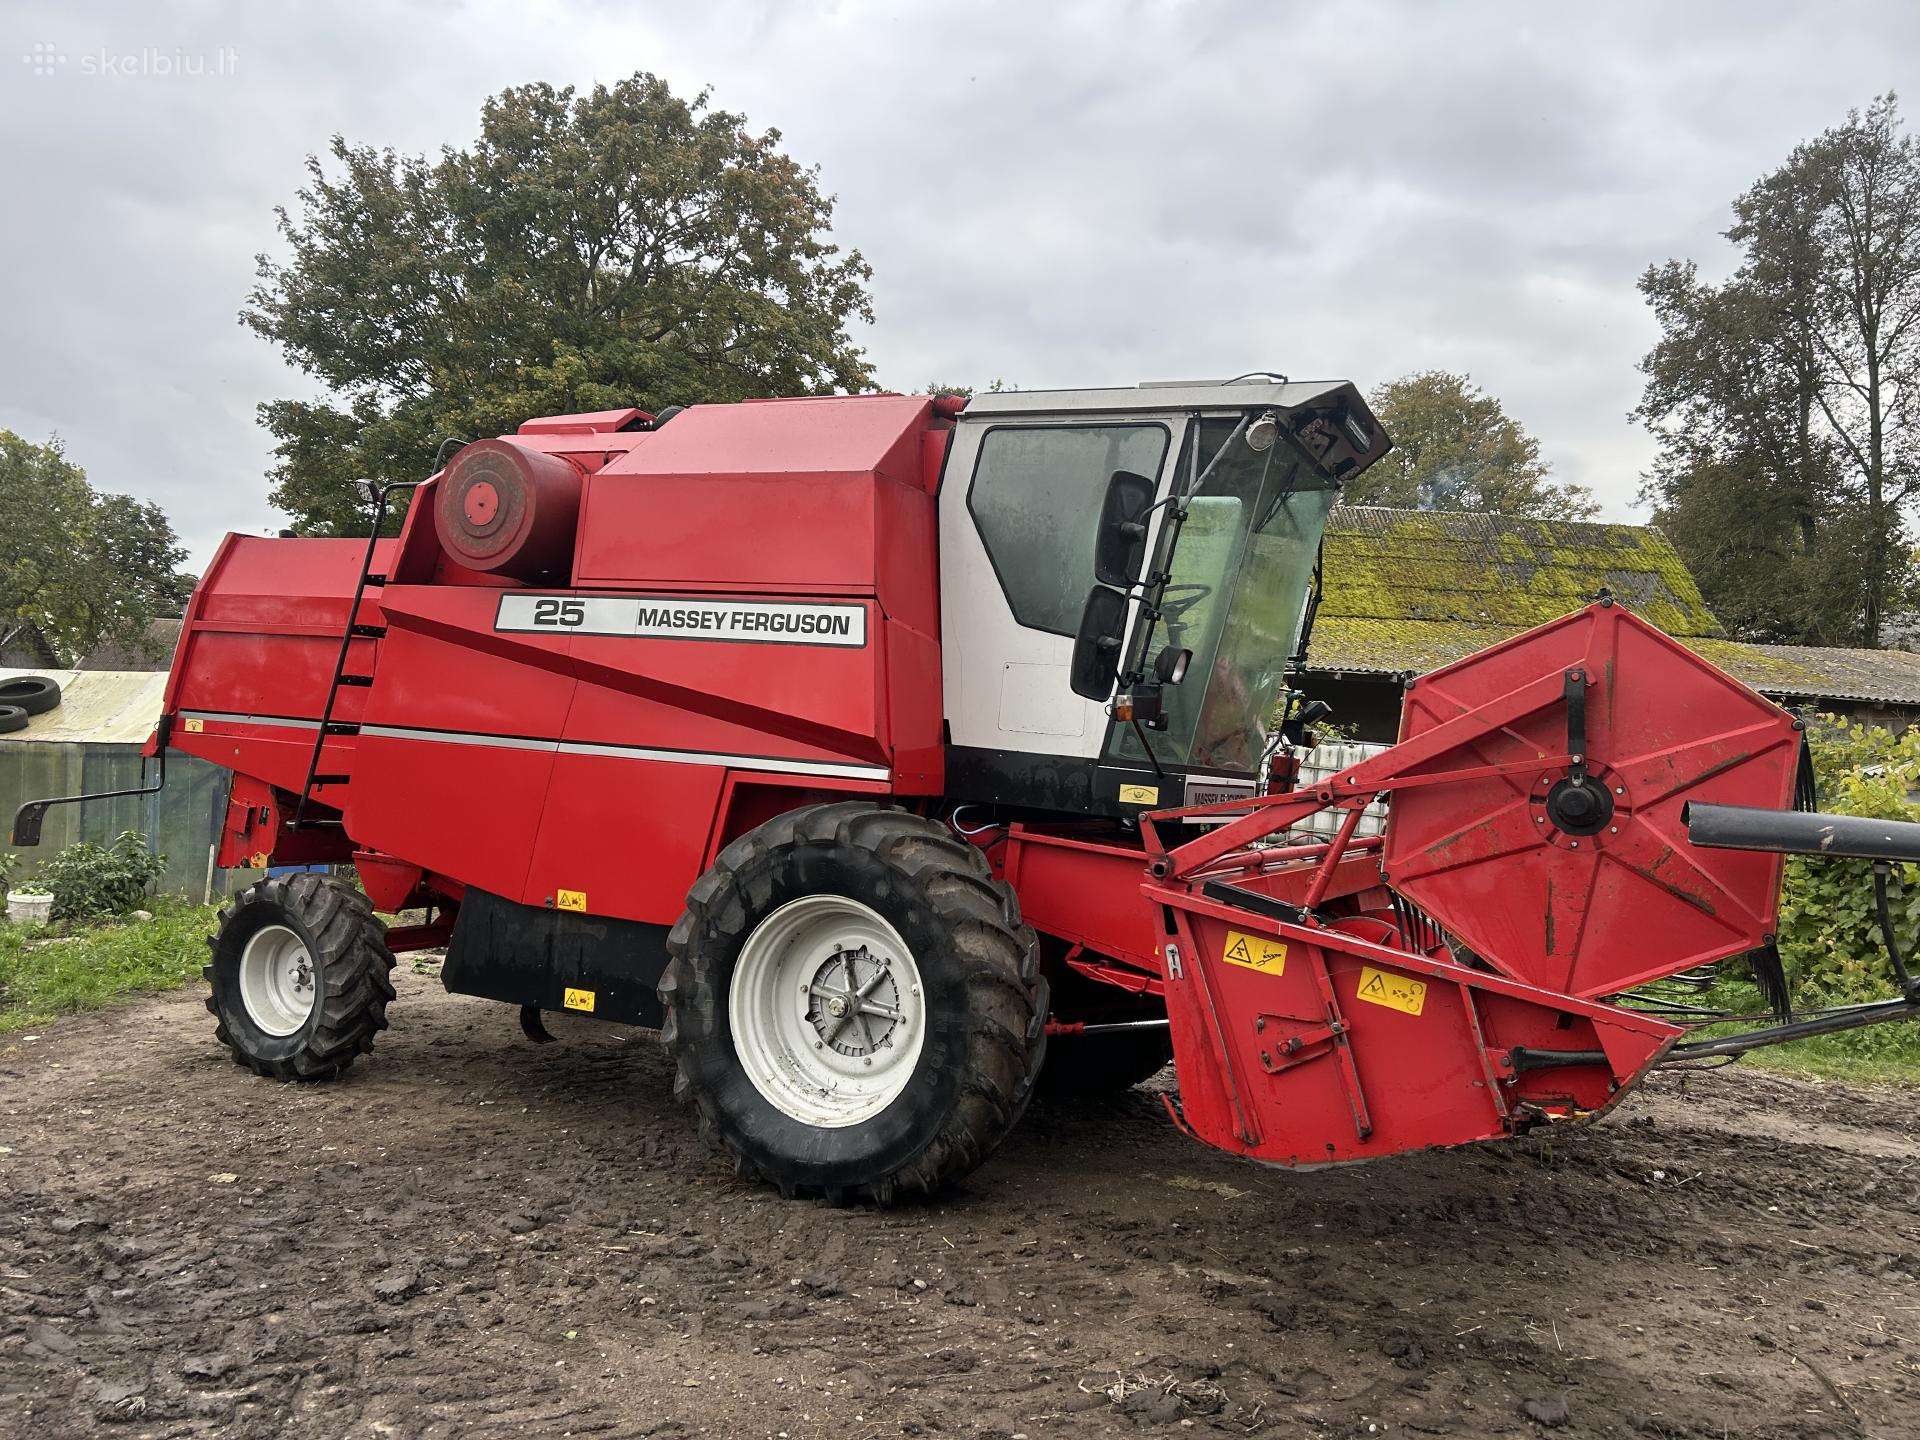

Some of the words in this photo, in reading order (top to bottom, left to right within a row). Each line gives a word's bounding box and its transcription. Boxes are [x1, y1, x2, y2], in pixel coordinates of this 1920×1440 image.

[533, 599, 586, 627] 25
[637, 608, 728, 630] MASSEY
[730, 611, 851, 636] FERGUSON
